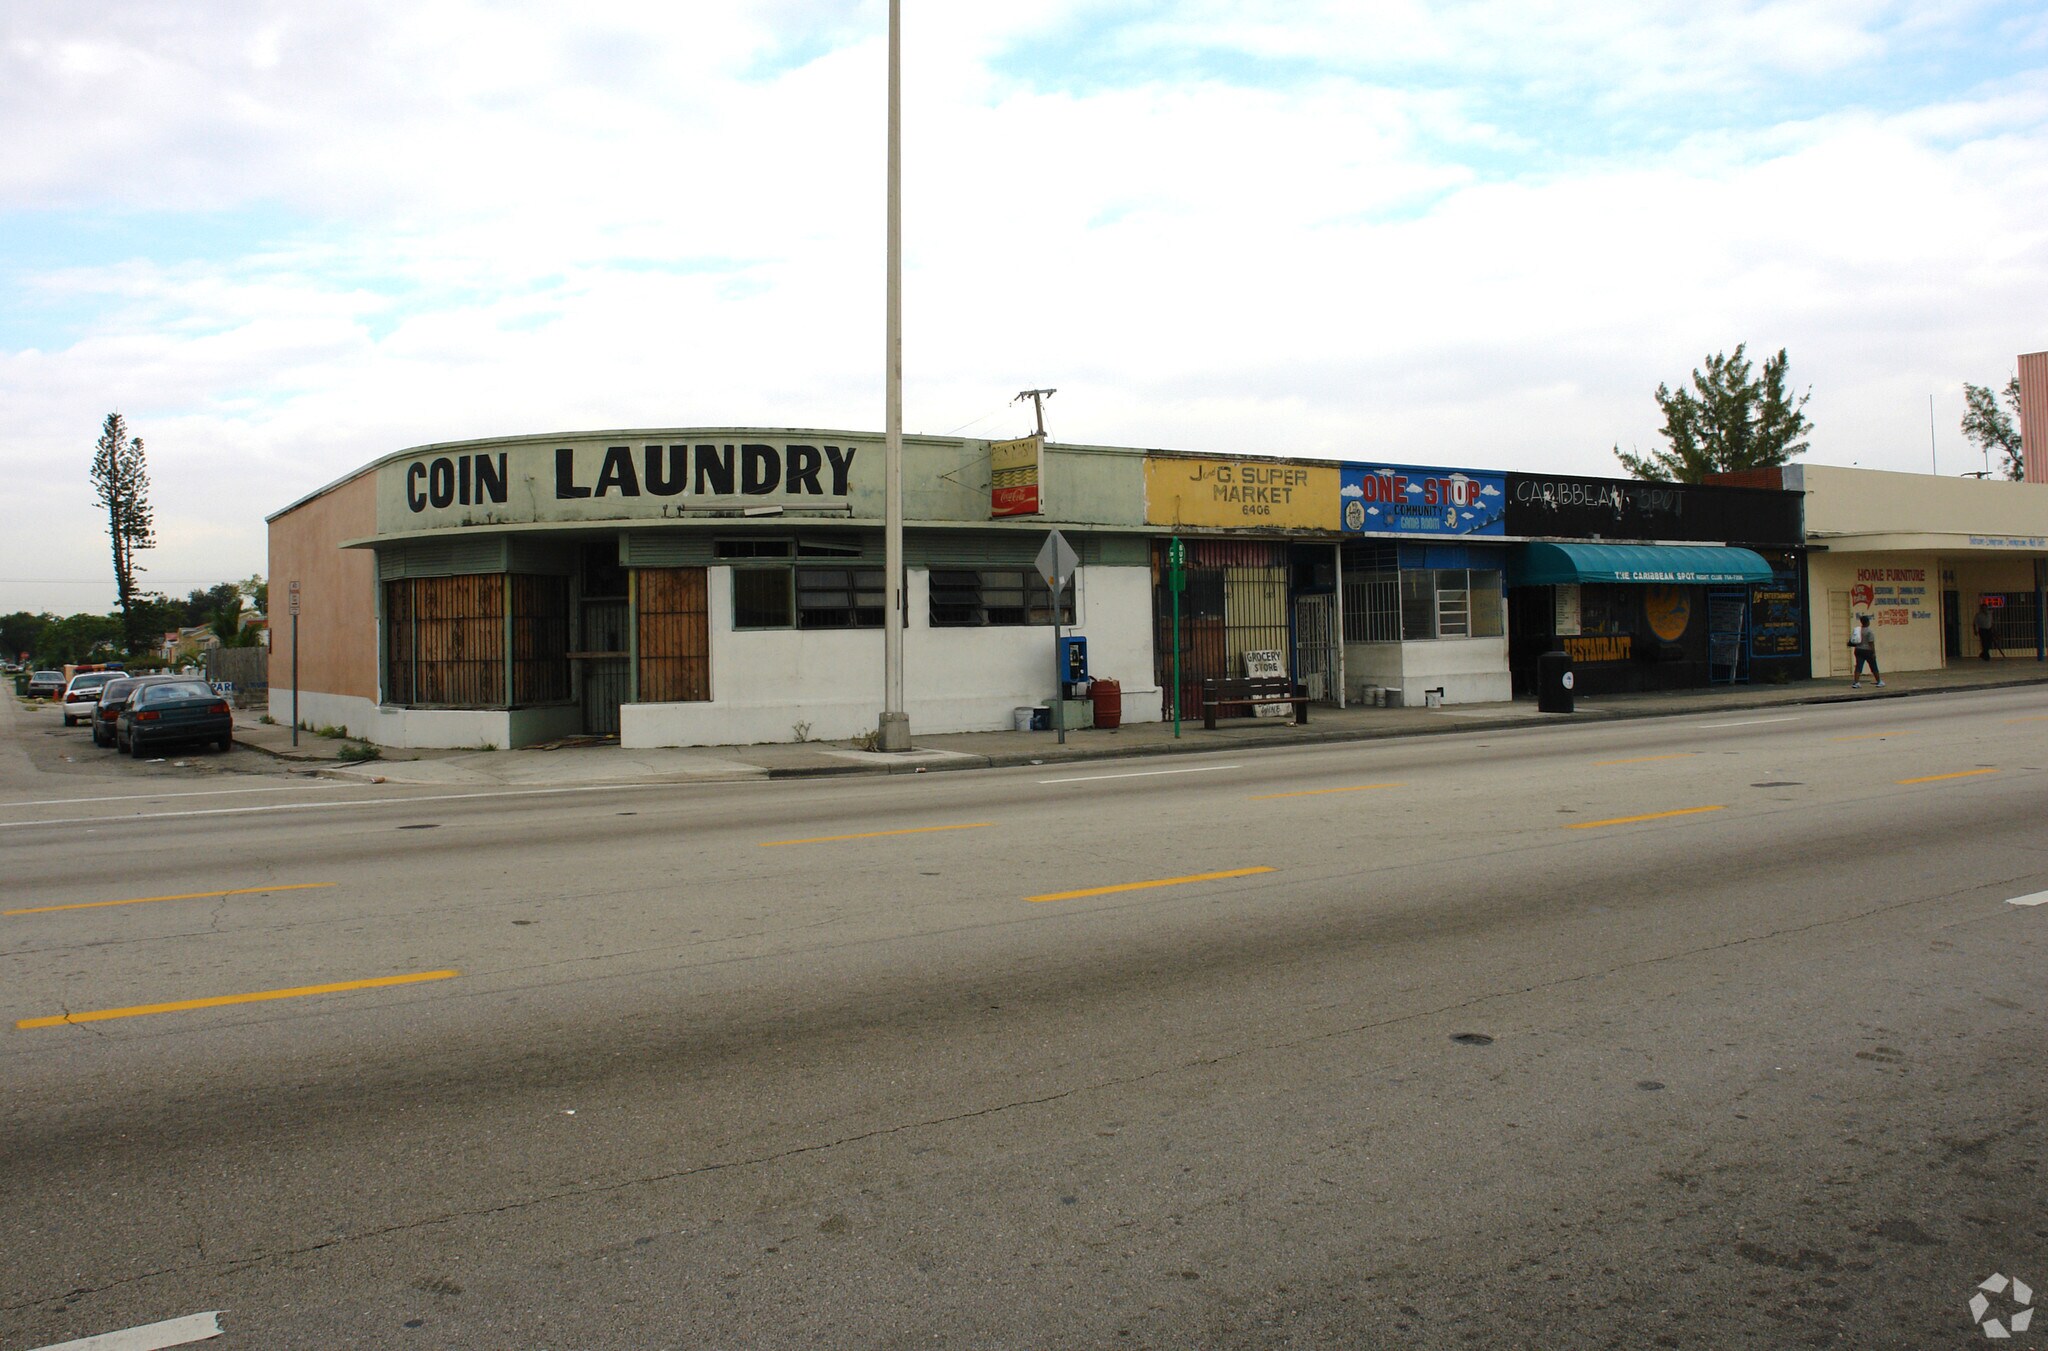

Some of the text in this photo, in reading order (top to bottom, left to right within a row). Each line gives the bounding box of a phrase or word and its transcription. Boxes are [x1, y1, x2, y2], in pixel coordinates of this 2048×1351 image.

[407, 444, 857, 513] COIN LAUNDRY
[1189, 465, 1203, 481] J
[1242, 467, 1308, 486] SUPER
[1213, 485, 1293, 504] MARKET
[1363, 474, 1481, 507] ONE STOP
[1517, 481, 1625, 511] CARIBBEAN
[1242, 505, 1270, 515] 6406
[1394, 505, 1444, 516] COMMUNITY
[1615, 571, 1630, 580] THE
[1633, 572, 1674, 580] CARIBBEAN
[1677, 572, 1696, 580] SPOT
[1857, 569, 1925, 581] HOME FURNITURE
[1246, 651, 1281, 662] GROCERY
[1563, 636, 1632, 662] RESTAURANT
[1254, 663, 1278, 672] STORE
